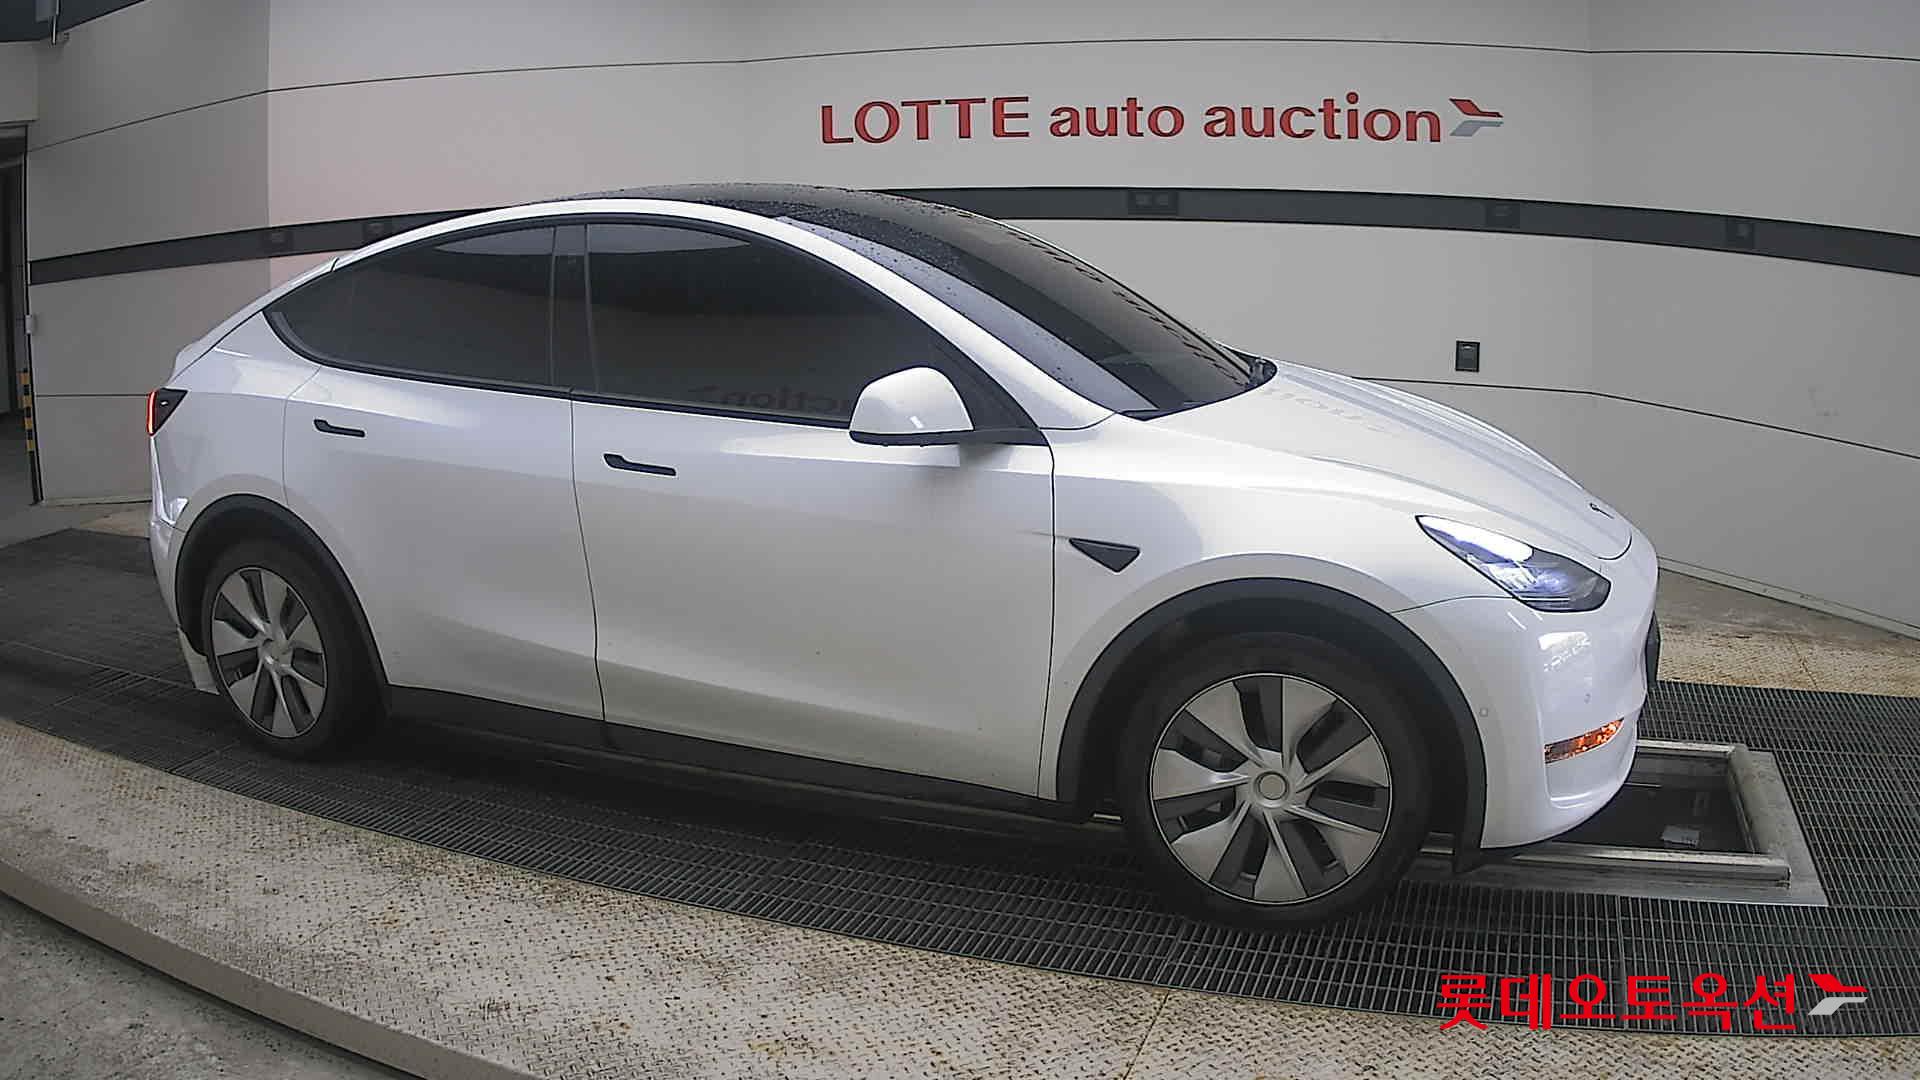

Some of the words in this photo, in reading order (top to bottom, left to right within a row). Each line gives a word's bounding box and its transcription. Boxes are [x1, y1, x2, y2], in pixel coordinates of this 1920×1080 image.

[820, 96, 1030, 144] LOTTE
[1049, 96, 1185, 138] auto
[1203, 92, 1442, 142] auction
